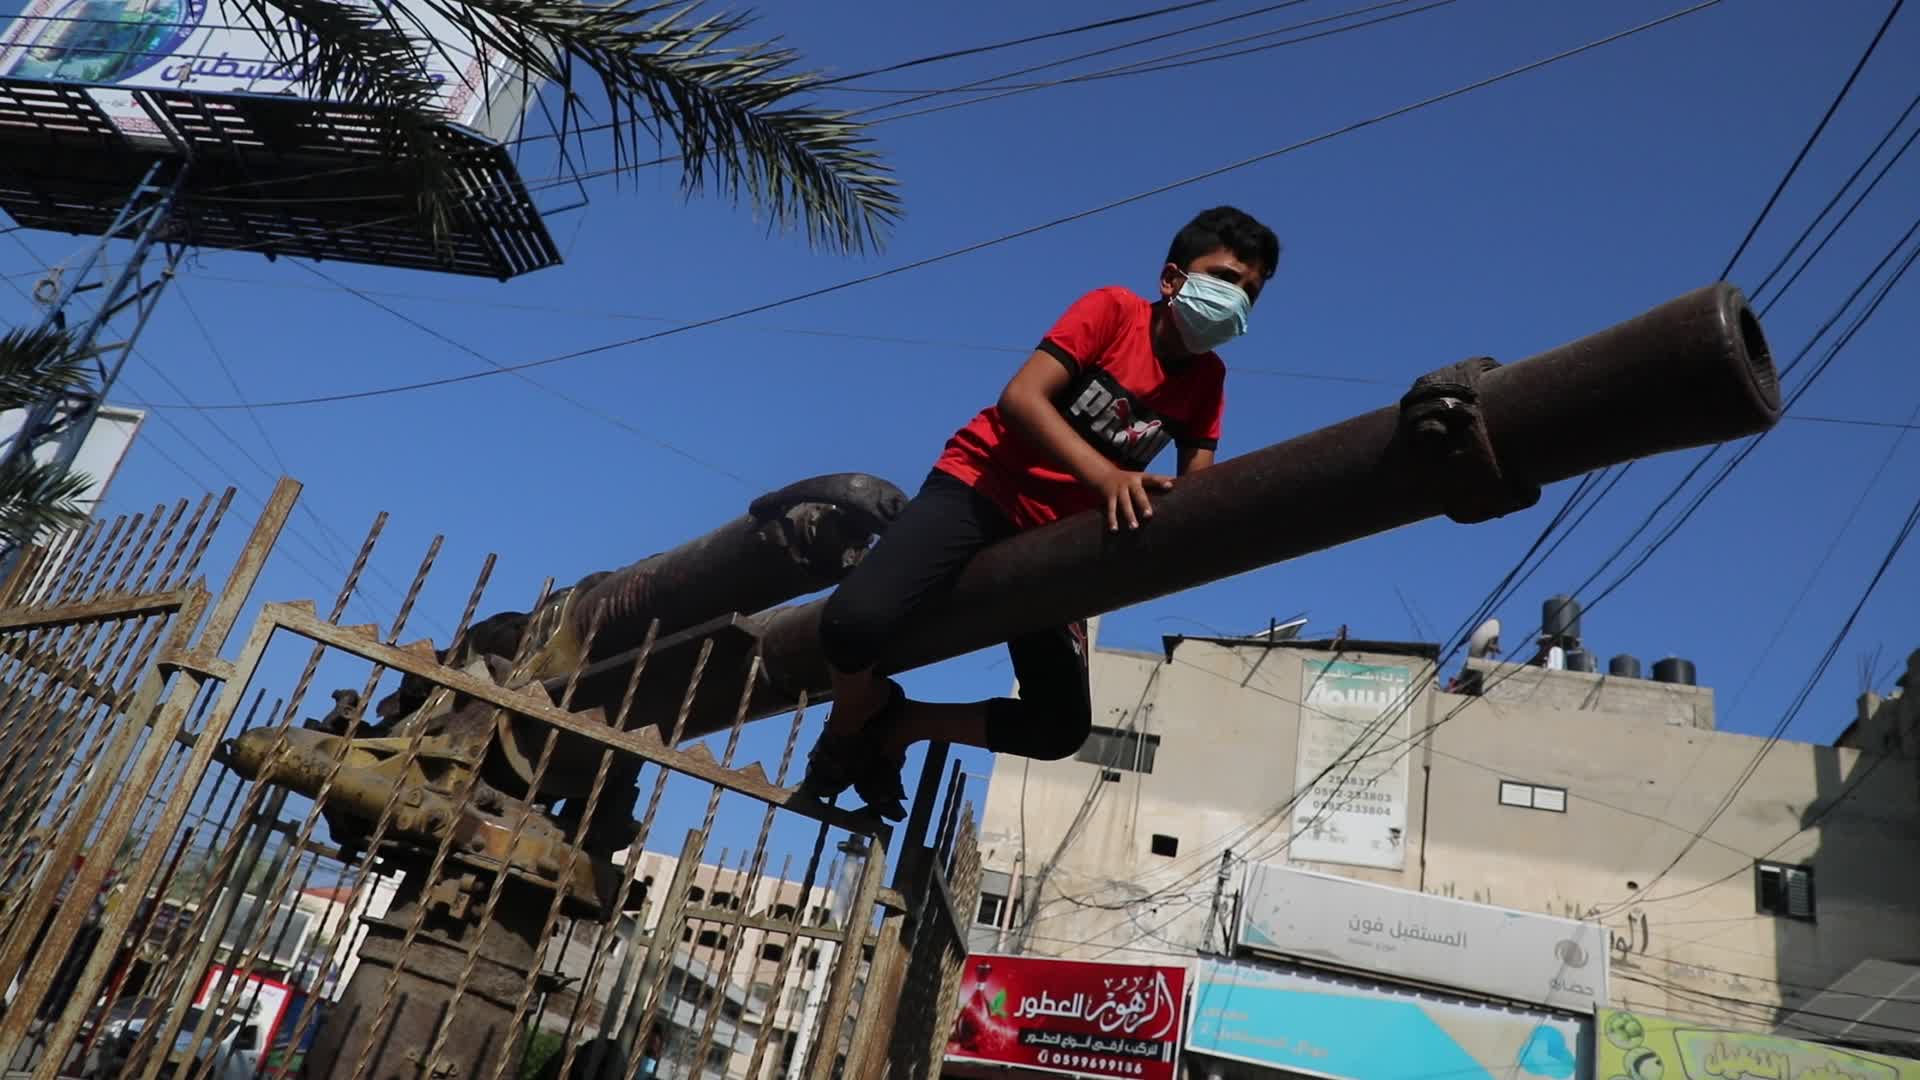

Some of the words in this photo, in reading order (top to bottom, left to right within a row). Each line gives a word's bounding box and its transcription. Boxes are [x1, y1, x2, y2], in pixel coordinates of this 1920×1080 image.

[1347, 913, 1384, 935] فون
[1389, 919, 1467, 949] المستقبل
[1014, 990, 1084, 1018] للعطور
